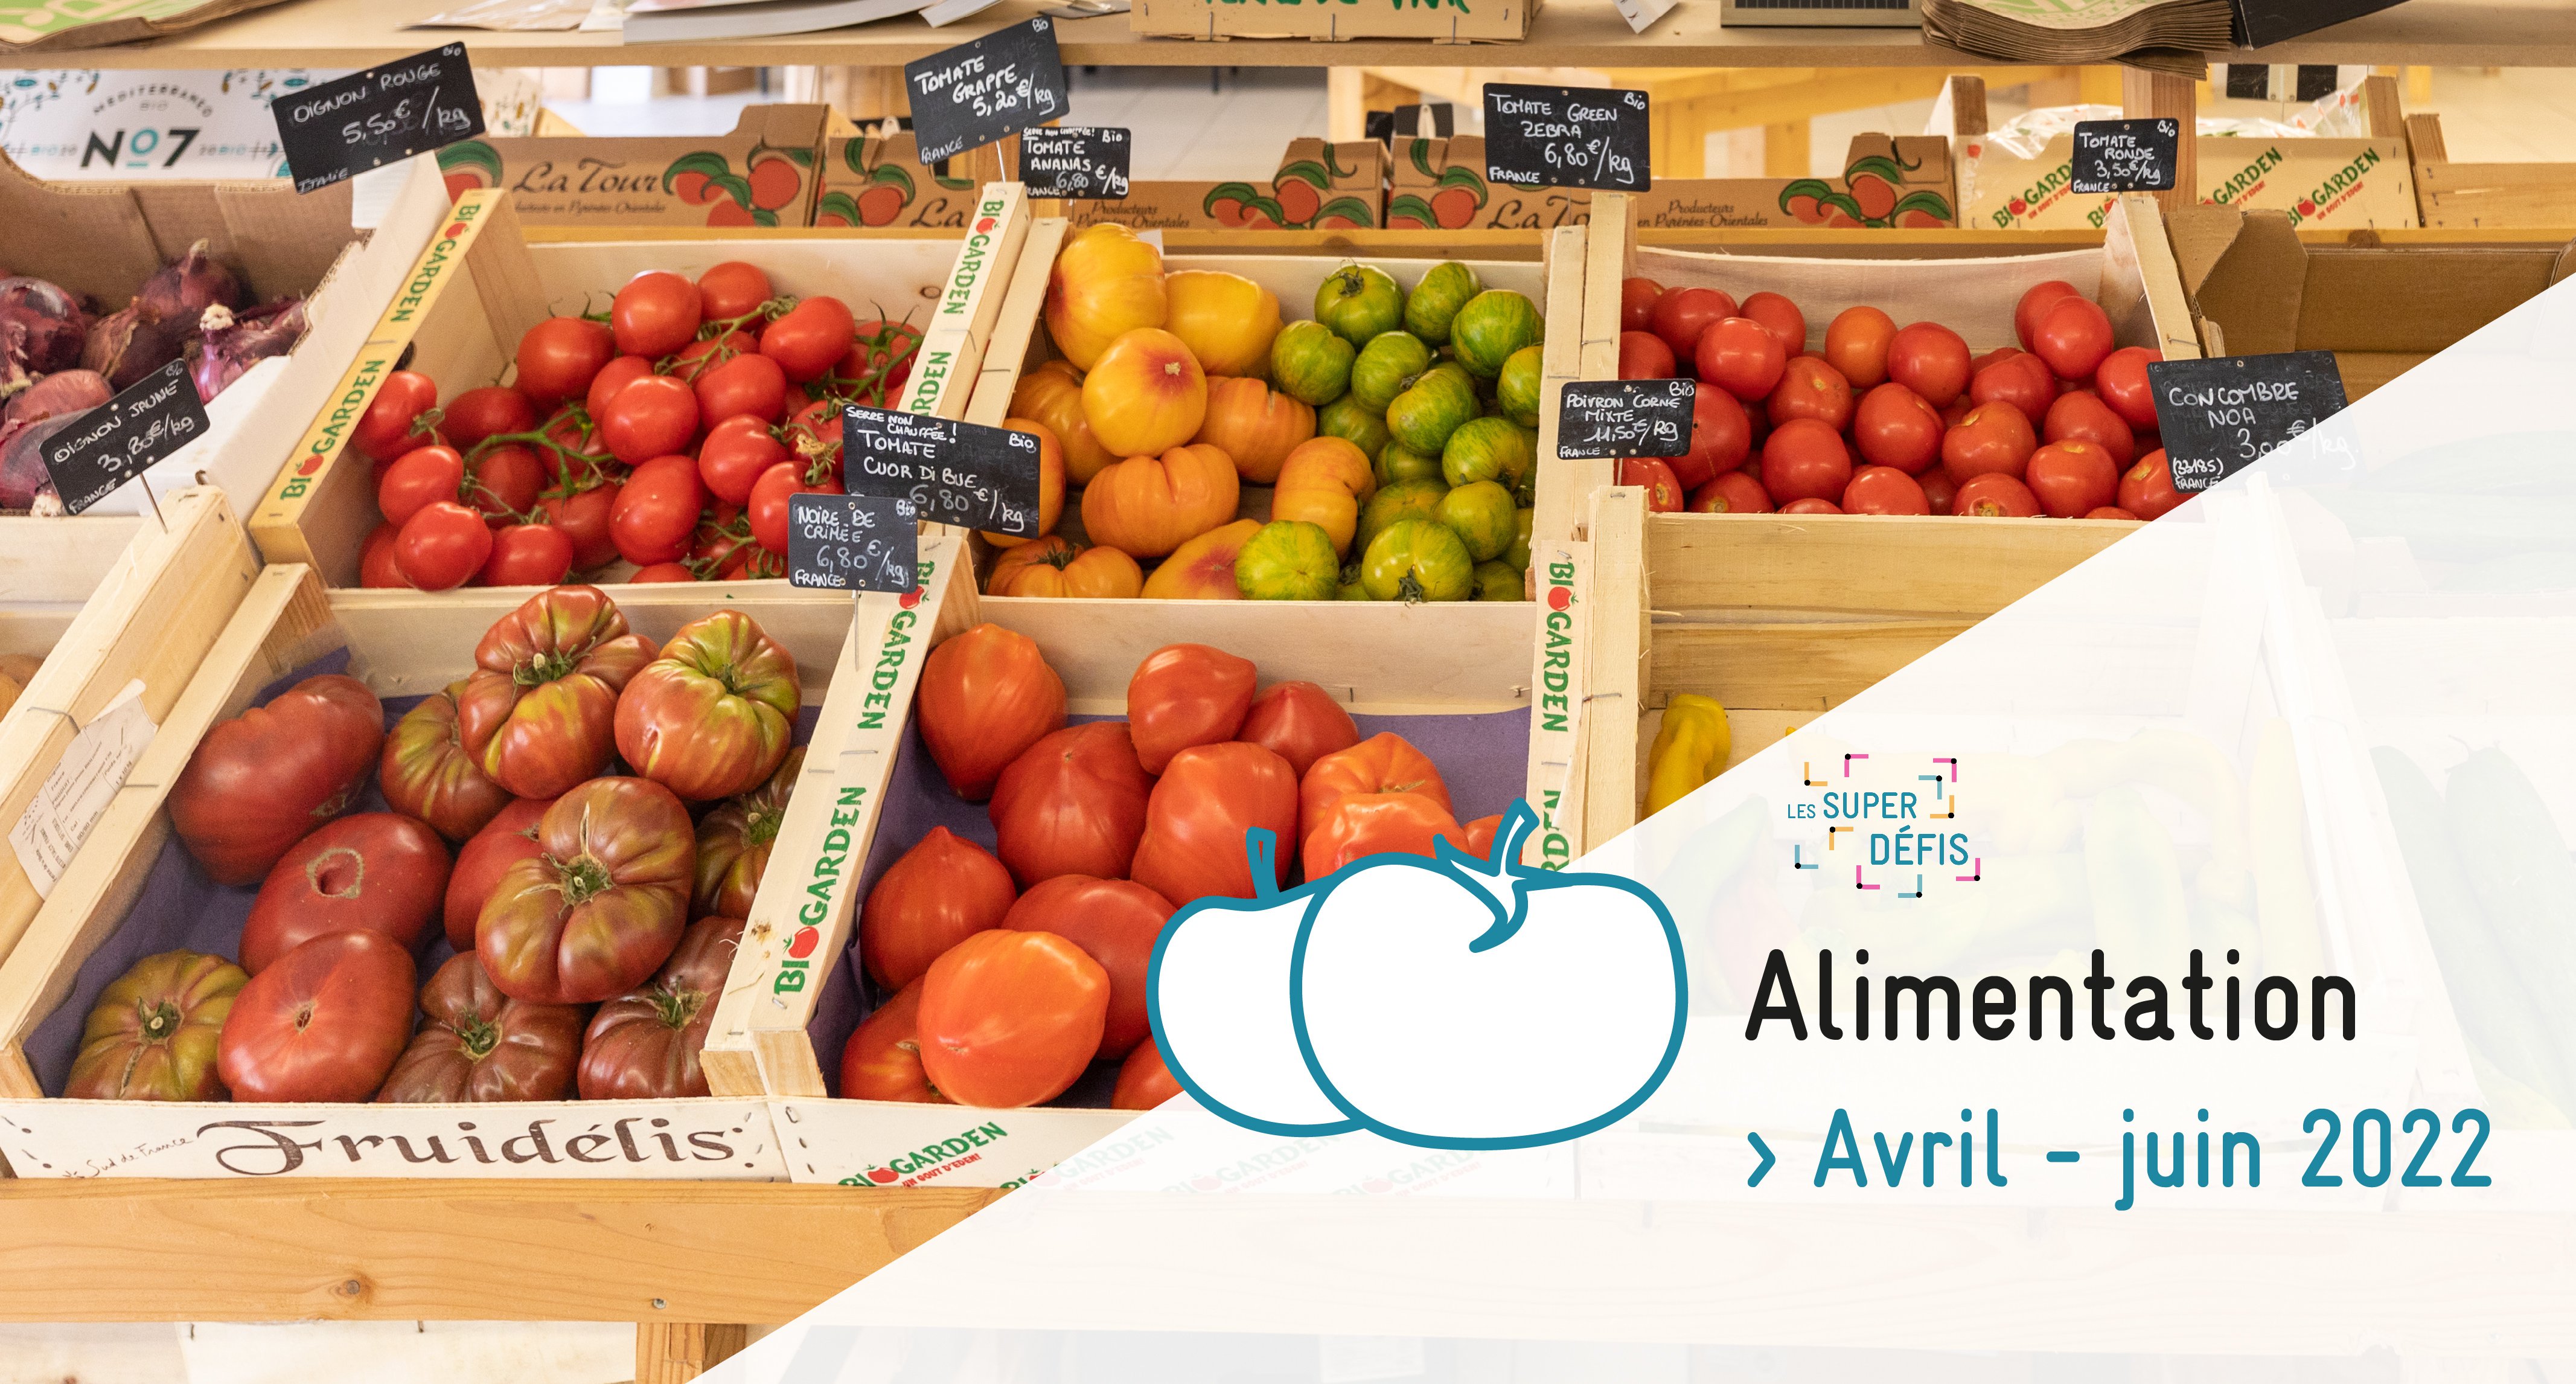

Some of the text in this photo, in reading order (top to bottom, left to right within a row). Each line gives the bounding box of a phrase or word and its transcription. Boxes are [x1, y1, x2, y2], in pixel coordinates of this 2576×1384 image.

[1032, 18, 1049, 33] Bio
[913, 55, 985, 95] TOMATE
[952, 63, 1018, 104] GRAPPE
[293, 63, 442, 123] OIGNON ROUGE
[1623, 91, 1646, 111] Bio
[1488, 92, 1618, 123] TOMATE GREEN
[1102, 129, 1123, 143] Bio
[1520, 120, 1582, 139] ZEBRA
[2156, 119, 2176, 138] Bio
[921, 135, 964, 165] FRANCE
[1023, 136, 1085, 155] TOMATE
[2079, 132, 2137, 149] TOMATE
[2104, 147, 2155, 161] RONDE
[1031, 156, 1092, 172] ANANAS
[298, 167, 348, 193] ITALIE
[512, 156, 660, 194] La Tour
[1488, 166, 1541, 184] FRANCE
[1026, 185, 1061, 197] RANCE
[2073, 179, 2110, 193] FRANCE
[909, 197, 965, 228] La
[1487, 199, 1541, 229] La
[1669, 199, 1735, 214] Producteurs
[1669, 381, 1695, 397] Bio
[2169, 381, 2300, 408] CONCOMBRE
[1566, 394, 1624, 408] POIVRON
[54, 379, 179, 463] OIGNON JAUNE
[846, 406, 914, 426] SERRE NON
[1585, 408, 1634, 423] MIXTE
[2207, 407, 2257, 429] NOA
[857, 429, 936, 459] TOMATE
[1008, 432, 1035, 449] Bio
[1559, 446, 1601, 458] FRANCE
[863, 456, 913, 479] CUOR
[942, 467, 977, 489] BUE
[2175, 476, 2222, 490] FRANCE
[68, 478, 117, 514] FRANCE
[797, 505, 876, 528] NOIRE DE
[794, 569, 841, 588] FRANCE
[774, 787, 867, 996] BIOGARDEN
[135, 1137, 193, 1156] France
[196, 1117, 735, 1176] Fruidélis
[916, 1167, 944, 1182] GOUT
